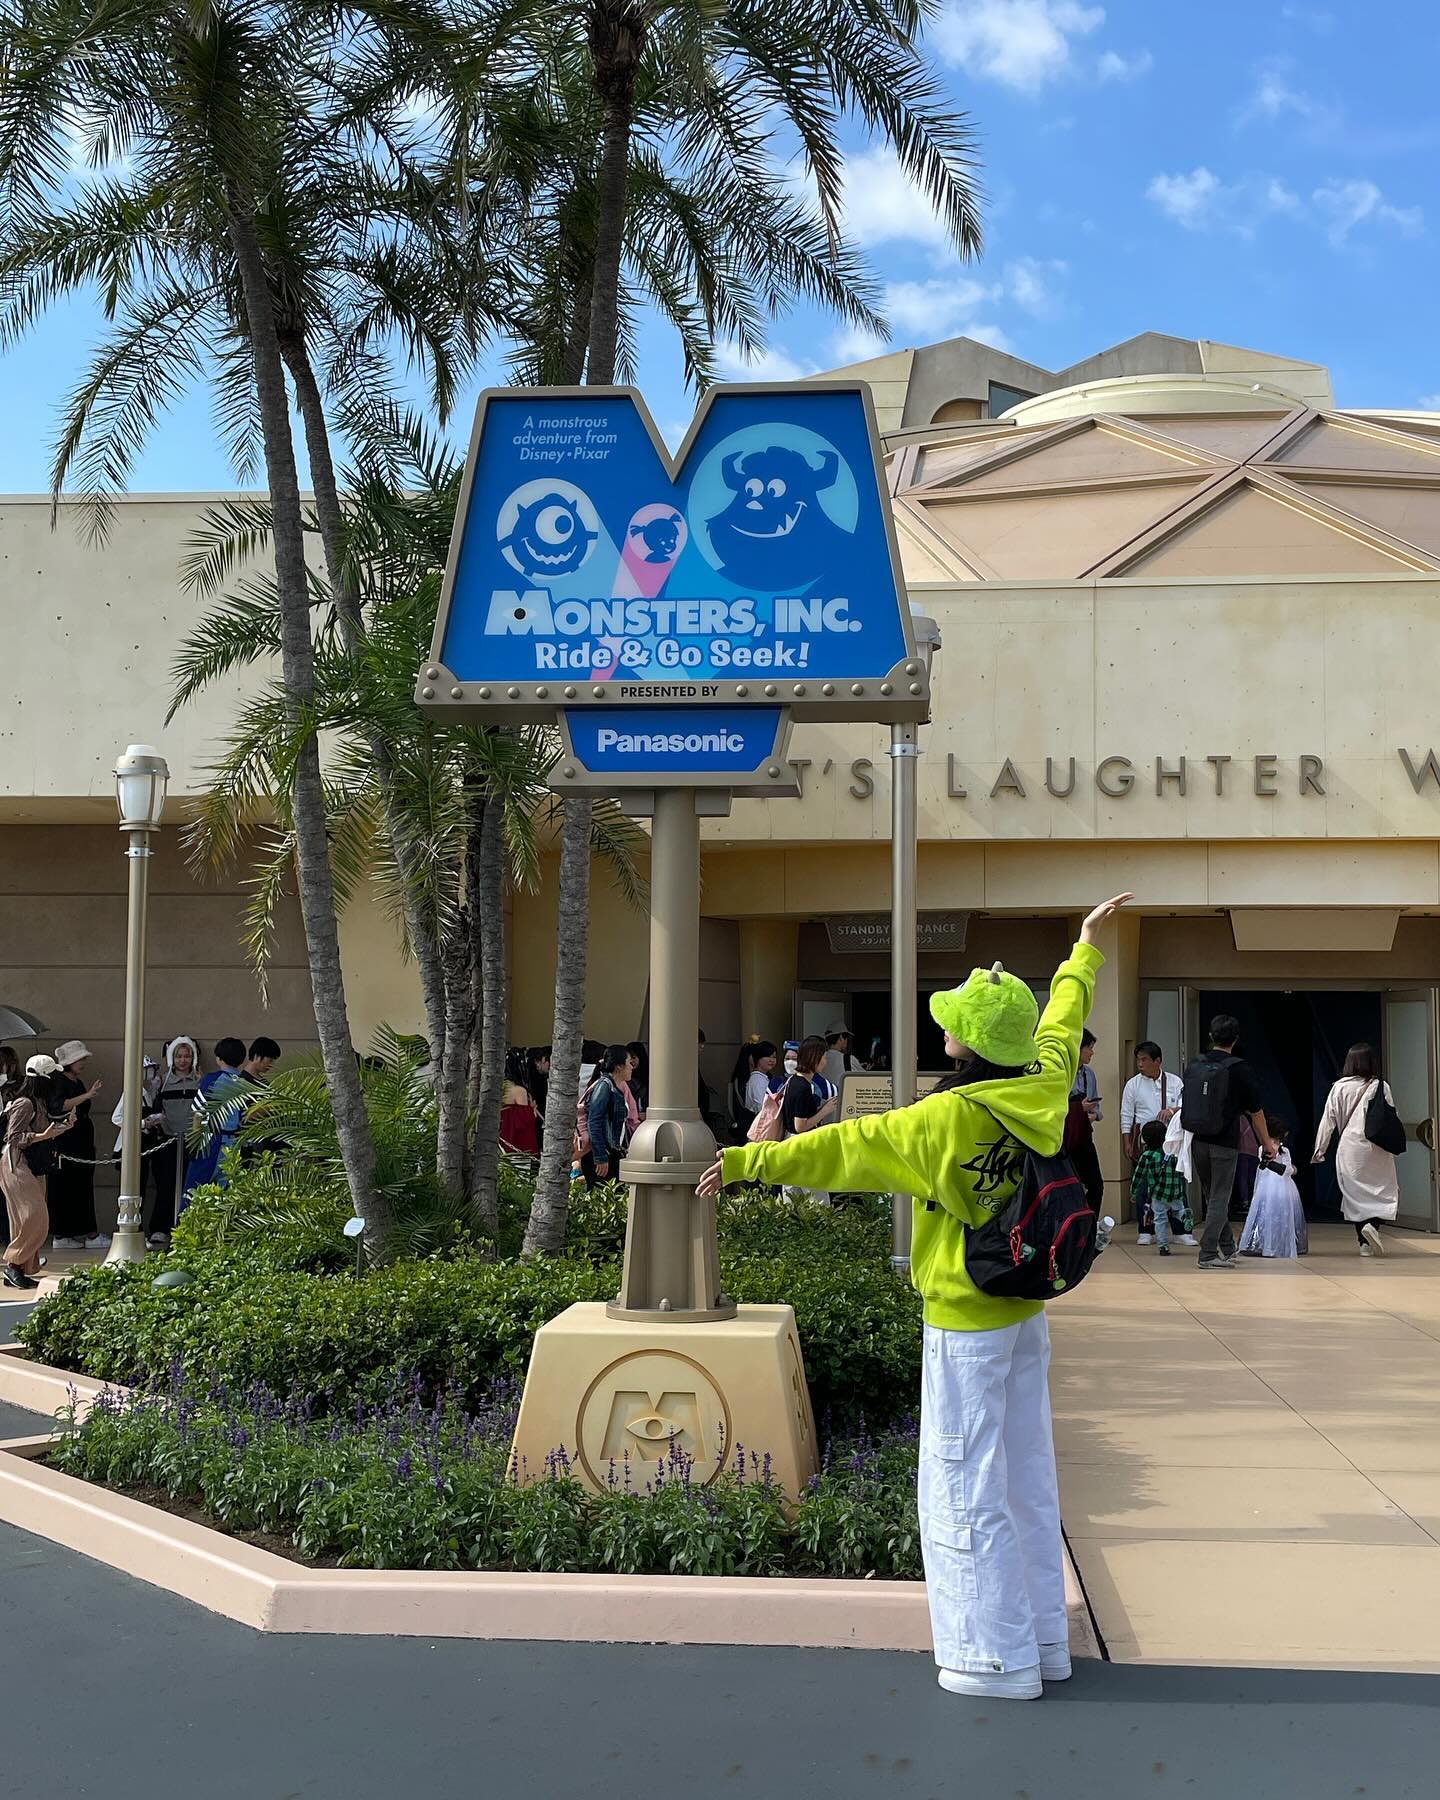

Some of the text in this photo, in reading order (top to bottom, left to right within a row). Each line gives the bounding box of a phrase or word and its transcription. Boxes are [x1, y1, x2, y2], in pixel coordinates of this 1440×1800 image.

[523, 415, 609, 429] A monstrous
[512, 430, 618, 445] adventure from
[774, 598, 863, 633] INC.
[535, 639, 811, 669] Ride & Go Seek!
[620, 686, 720, 698] PRESENTED BY
[597, 728, 745, 753] Panasonic
[788, 758, 874, 799] T'S
[947, 753, 1327, 798] LAUGHTER
[838, 923, 957, 936] STANDBY RANCE
